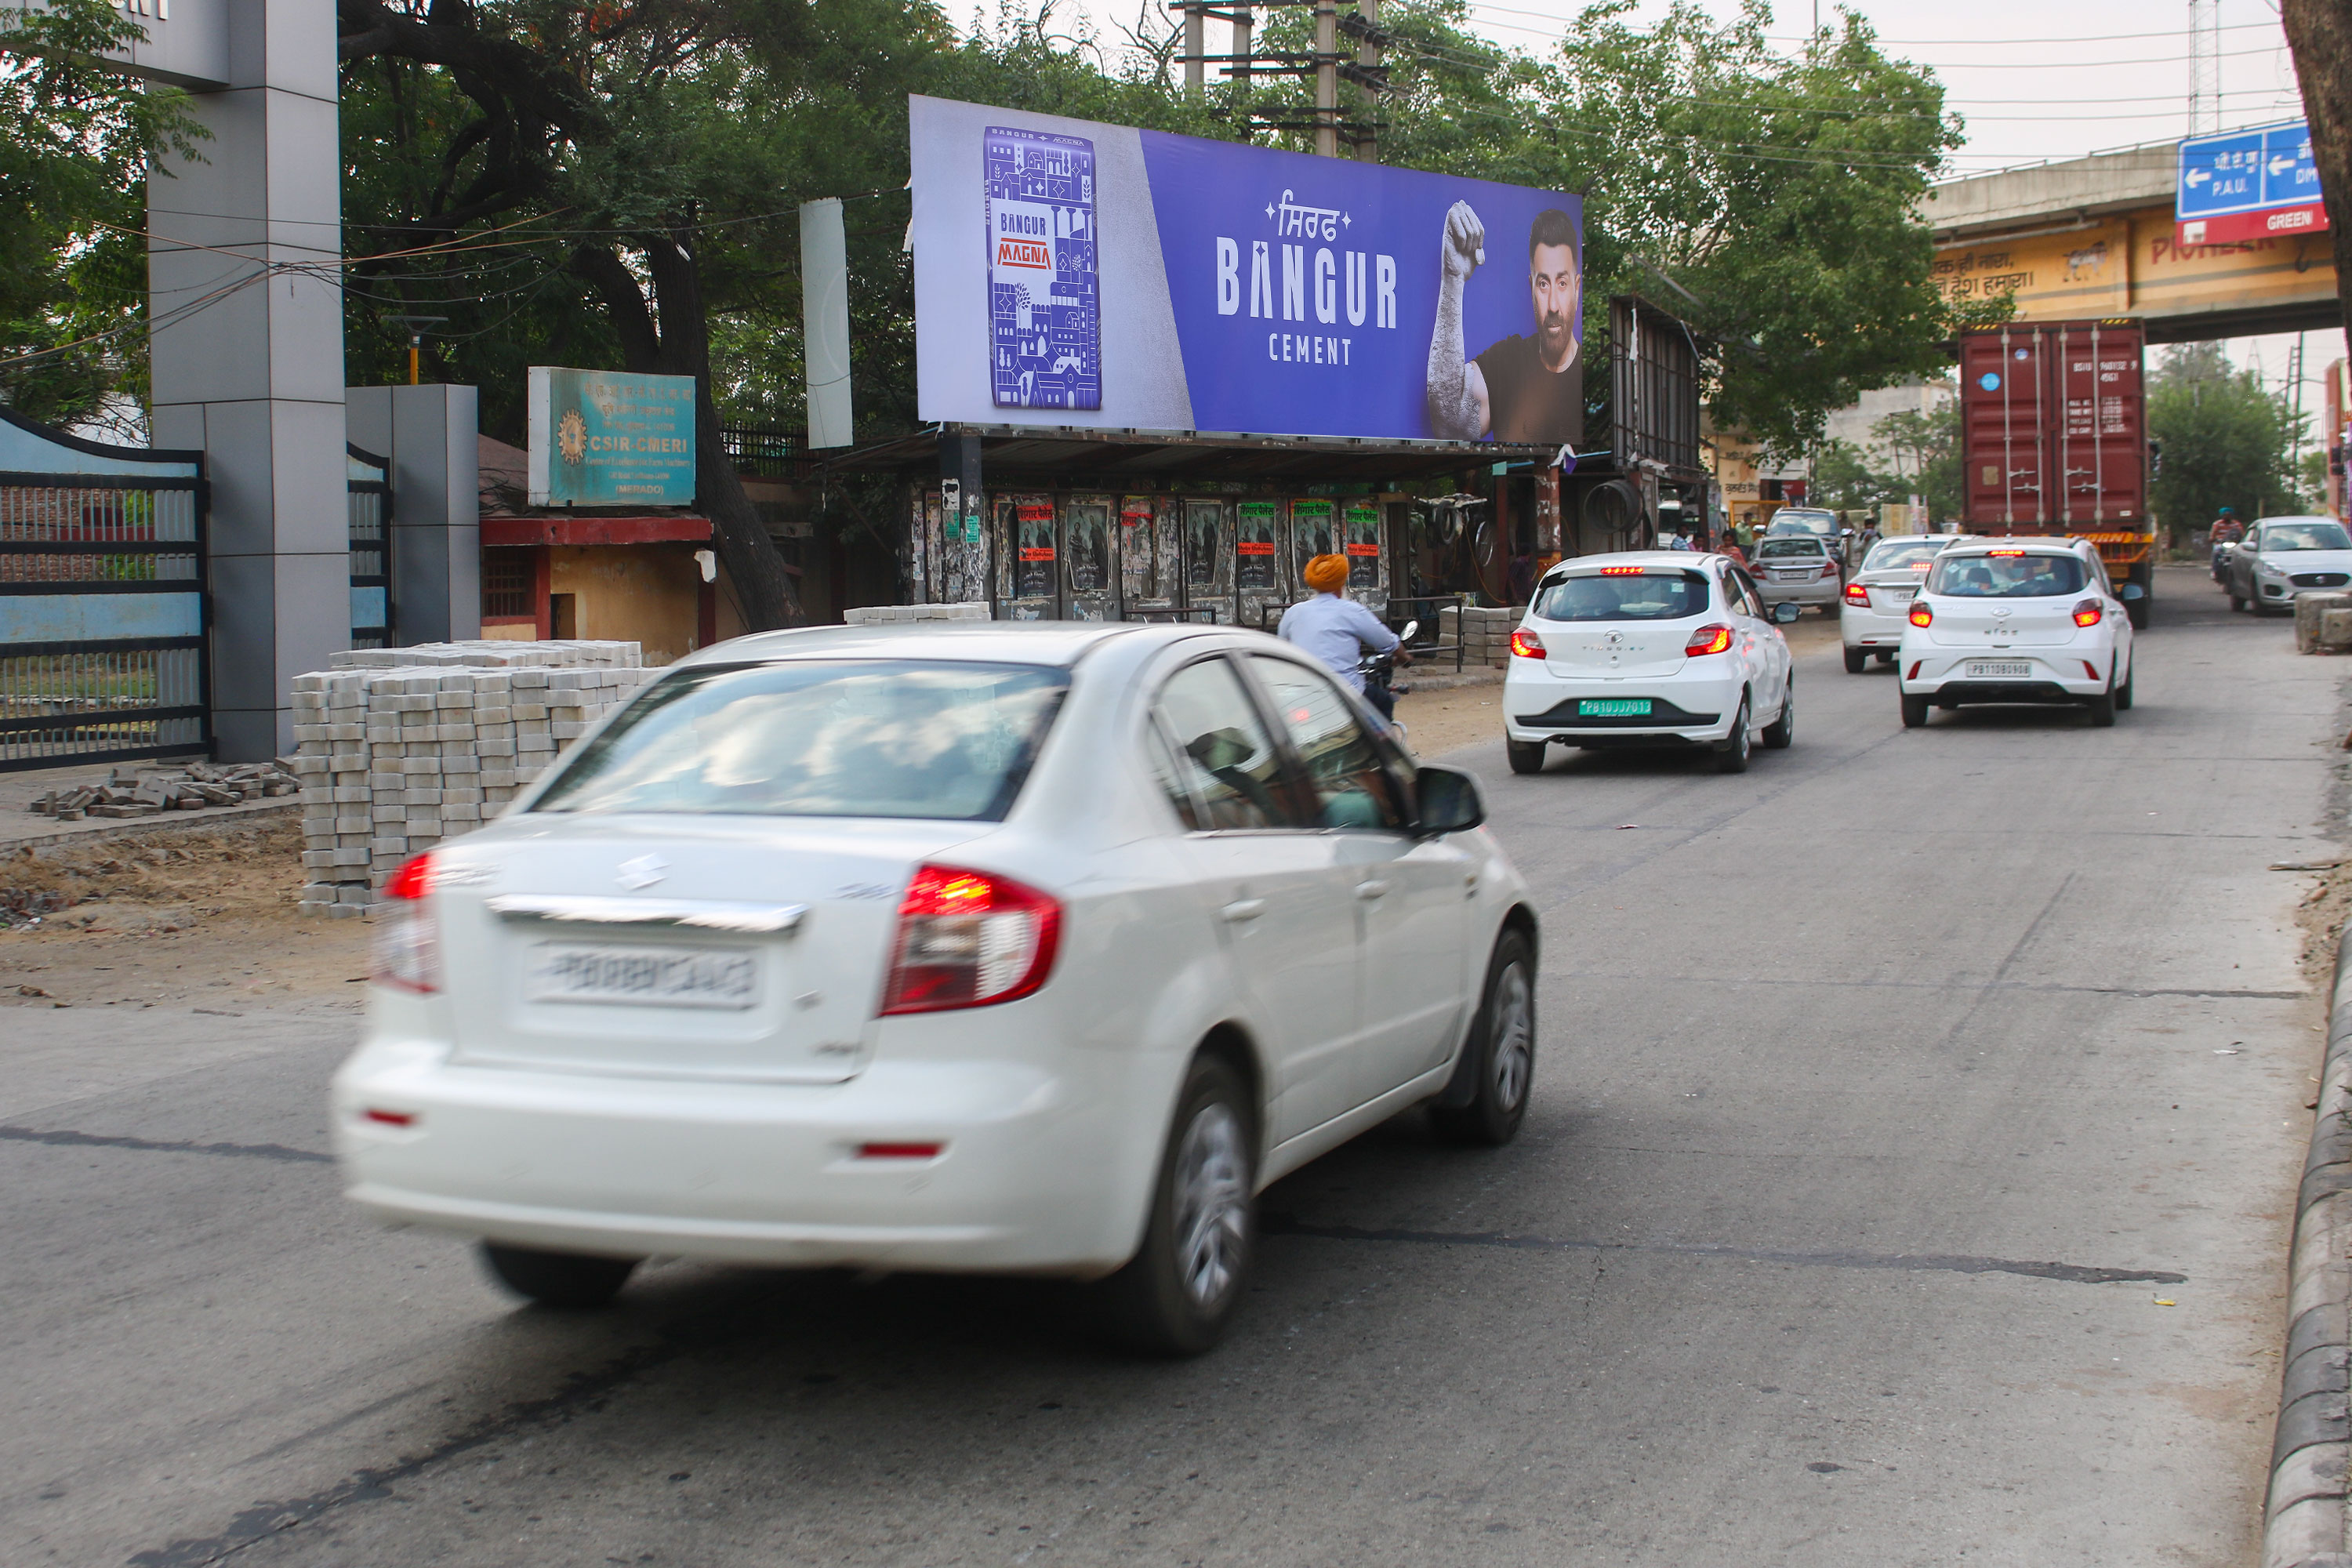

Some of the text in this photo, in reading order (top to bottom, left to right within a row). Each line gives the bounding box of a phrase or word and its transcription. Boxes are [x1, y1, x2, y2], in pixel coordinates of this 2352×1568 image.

[991, 128, 1084, 147] BANGUR MAGNA
[2212, 176, 2249, 197] P.A.U.
[1000, 212, 1047, 236] BANGUR
[1278, 188, 1341, 241] ਸਿਰਫ
[2267, 210, 2314, 230] GREEN
[997, 242, 1051, 270] MAGNA
[1216, 237, 1397, 328] BANGUR
[1269, 332, 1352, 366] CEMENT
[590, 436, 688, 453] CSIR-CMERI
[615, 485, 664, 495] (MERADO)
